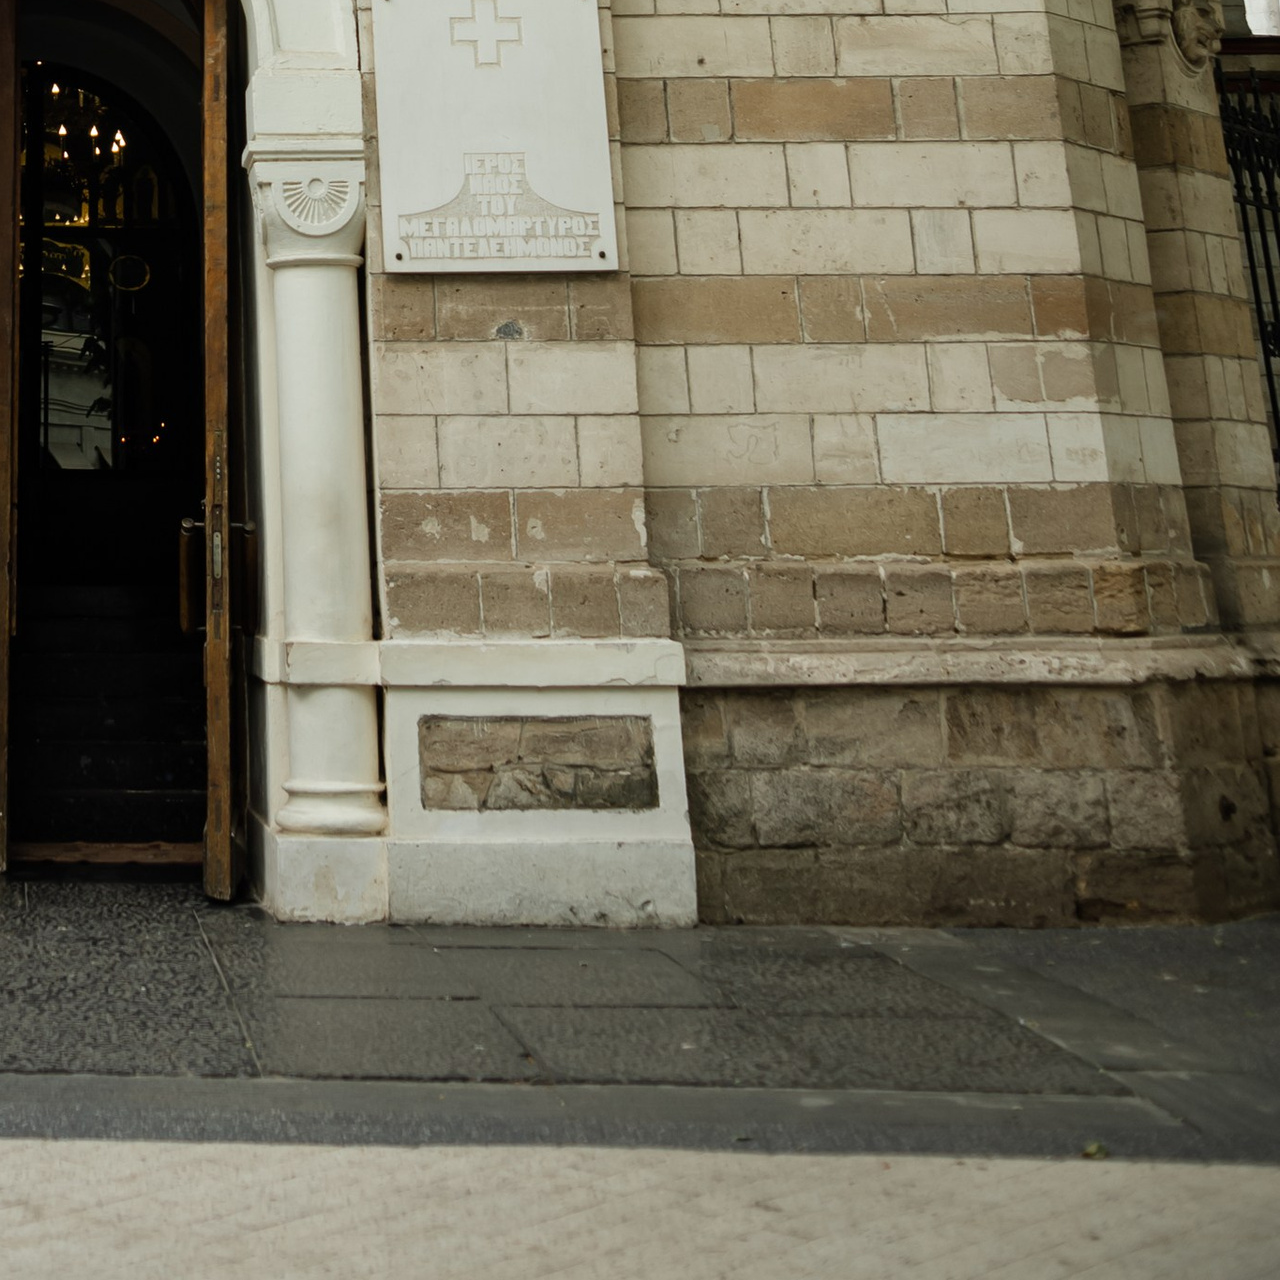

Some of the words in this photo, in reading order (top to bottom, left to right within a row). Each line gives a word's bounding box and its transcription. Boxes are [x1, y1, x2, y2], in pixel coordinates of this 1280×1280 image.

[465, 153, 525, 174] ΙΕΡΟΣ
[469, 174, 524, 195] ΝΑΟΣ
[477, 195, 518, 216] ΤΟΥ
[399, 215, 600, 237] ΜΕΓΑΛΟΜΑΡΤΥΡΟΣ
[409, 237, 592, 258] ΠΑΝΤΕΛΕΗΜΟΝΟΣ
